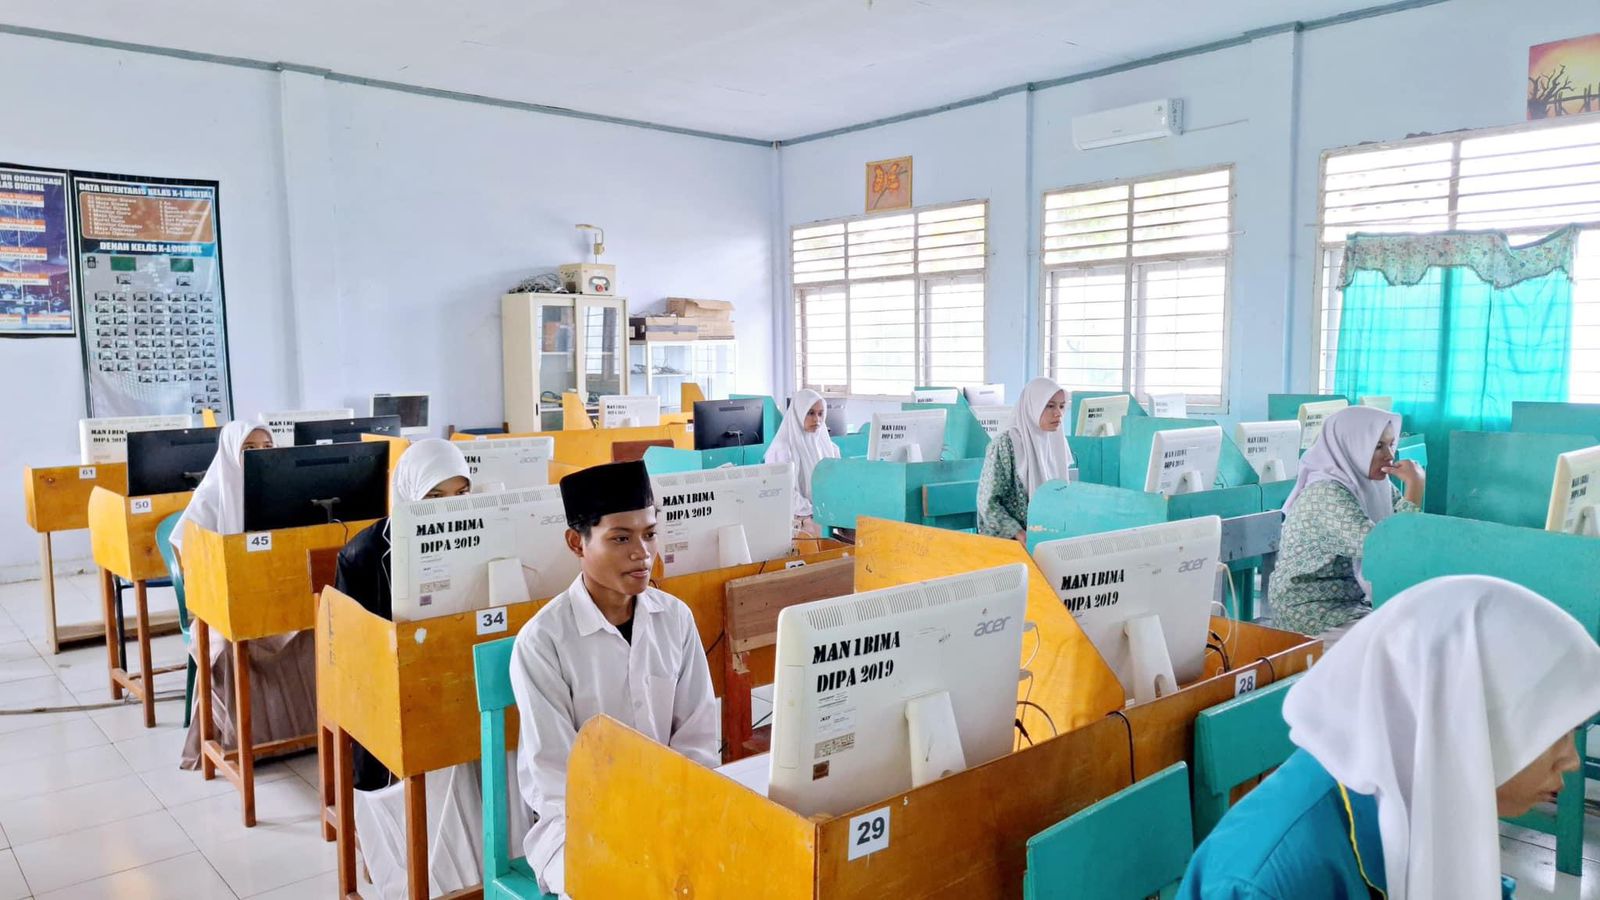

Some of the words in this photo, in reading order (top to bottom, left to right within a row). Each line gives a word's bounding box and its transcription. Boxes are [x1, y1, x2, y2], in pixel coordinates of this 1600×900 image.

[13, 175, 62, 186] ORGANISASI
[14, 182, 45, 192] DIGITAL
[79, 183, 99, 192] DATA
[147, 187, 171, 197] KELAS
[99, 241, 130, 251] DENAH
[131, 243, 157, 252] KELAS
[662, 494, 685, 507] MAN
[757, 487, 783, 499] acer
[135, 501, 149, 509] 50
[540, 513, 566, 526] ace
[666, 508, 690, 522] DIPA
[691, 506, 712, 519] 2019
[416, 521, 445, 537] MAN
[251, 536, 269, 546] 45
[420, 540, 452, 554] DIPA
[453, 535, 481, 550] 2019
[1178, 557, 1208, 573] acer
[1061, 574, 1089, 591] MAN
[1063, 595, 1092, 612] DIPA
[1093, 591, 1119, 608] 2019
[482, 611, 504, 627] 34
[974, 616, 1011, 637] acer
[812, 640, 851, 664] MAN
[863, 631, 901, 655] BIMA
[816, 667, 857, 693] DIPA
[859, 659, 895, 683] 2019
[1239, 675, 1254, 694] 28
[856, 816, 885, 846] 29
